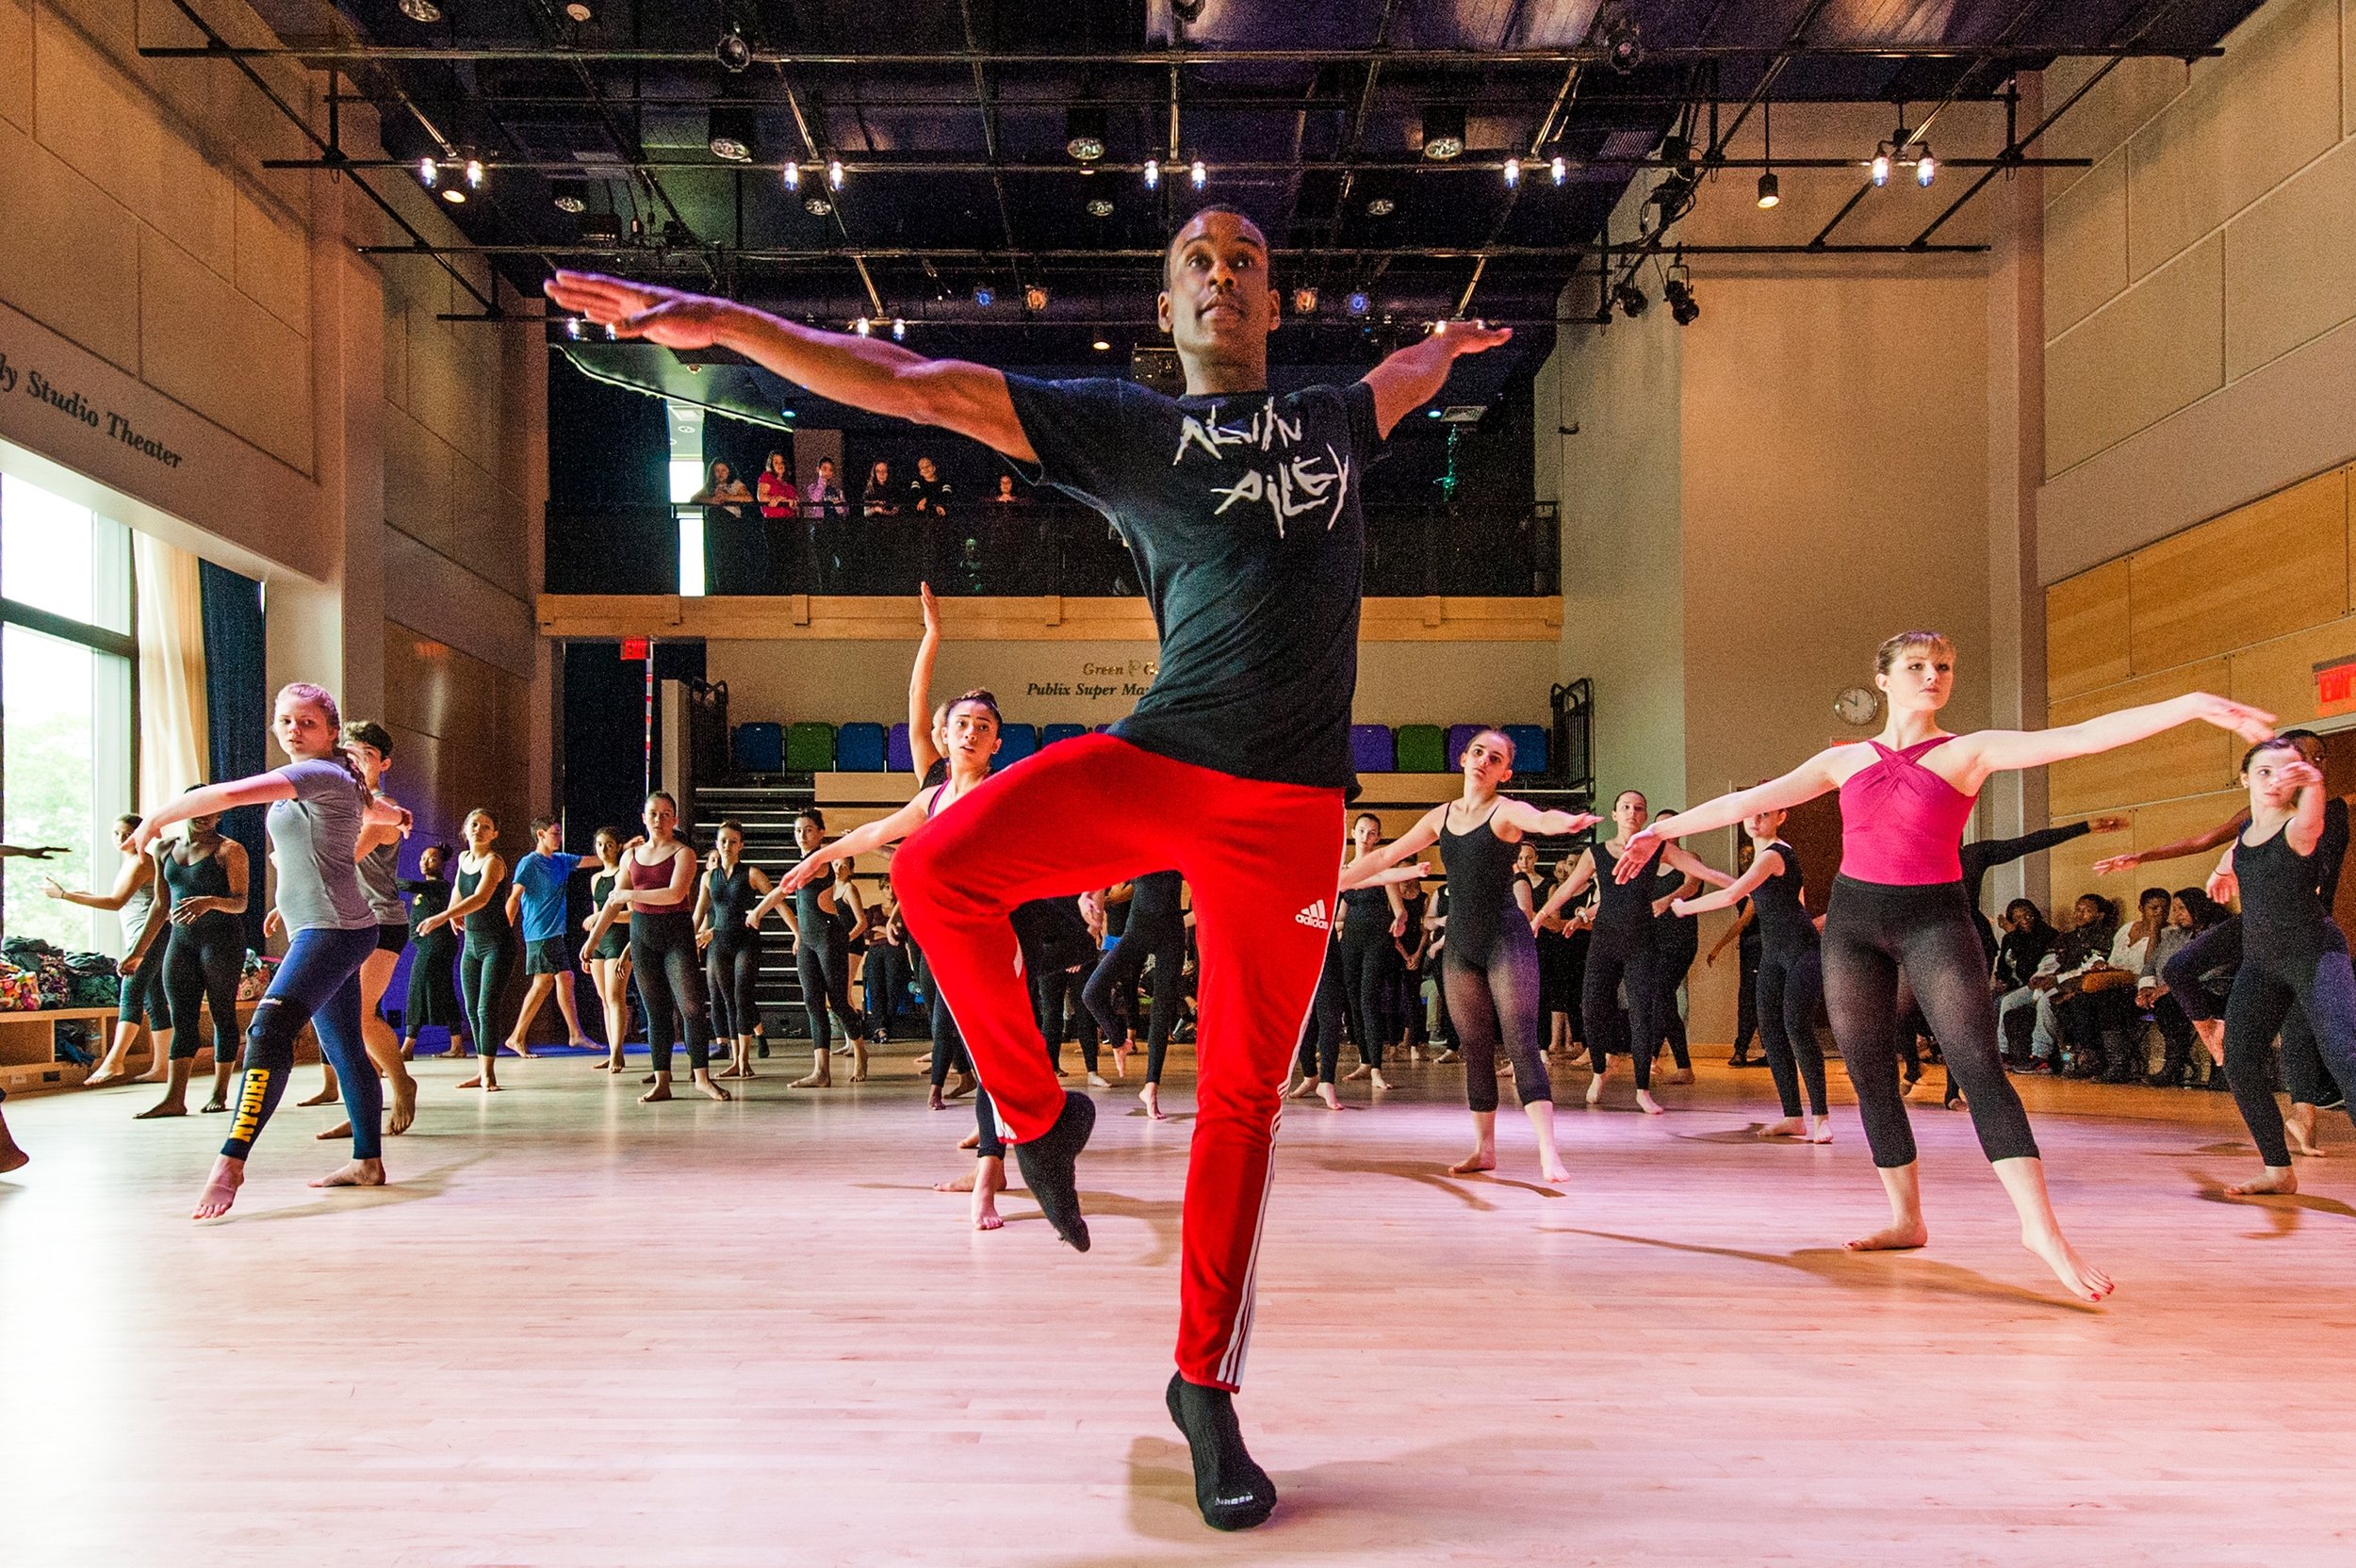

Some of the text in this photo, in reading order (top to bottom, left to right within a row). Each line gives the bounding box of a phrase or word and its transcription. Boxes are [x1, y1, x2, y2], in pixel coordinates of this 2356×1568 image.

[26, 370, 99, 427] Studio
[106, 412, 182, 468] Theater
[1083, 662, 1123, 676] Green
[1026, 683, 1071, 696] Publix
[1075, 683, 1117, 699] Super
[1295, 913, 1329, 930] adidas
[228, 1068, 271, 1143] CHIGAN
